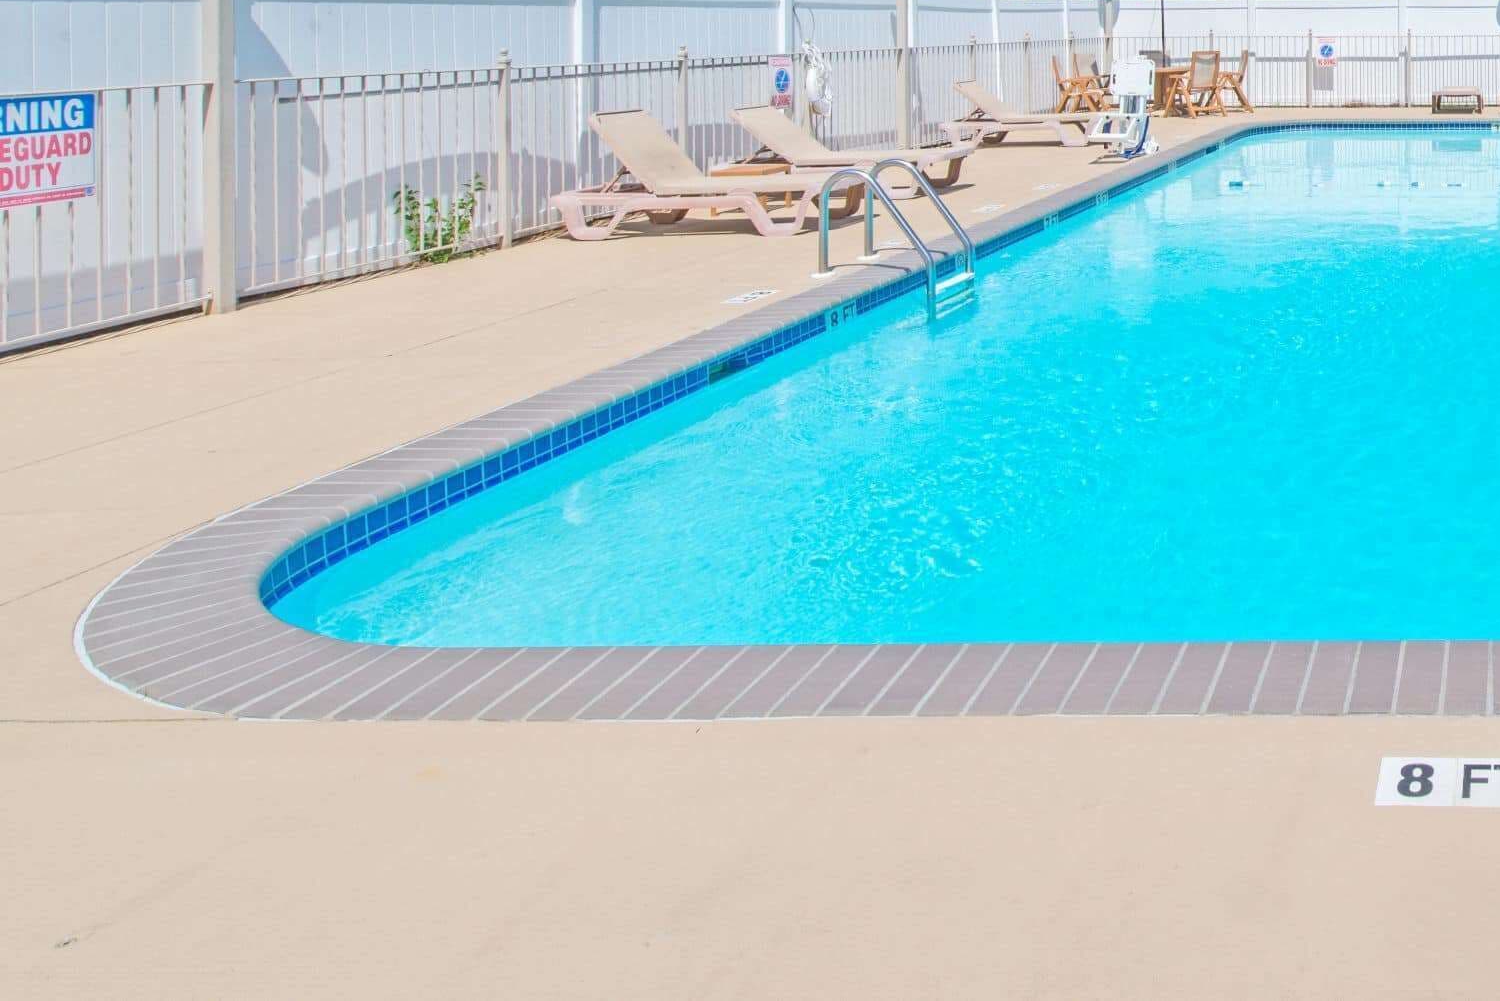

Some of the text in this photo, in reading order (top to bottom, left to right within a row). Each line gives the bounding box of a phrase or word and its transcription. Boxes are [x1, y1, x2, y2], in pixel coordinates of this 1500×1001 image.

[0, 99, 84, 133] NING
[0, 162, 62, 192] DUTY
[830, 301, 855, 326] 8 FT
[1397, 763, 1435, 797] 8
